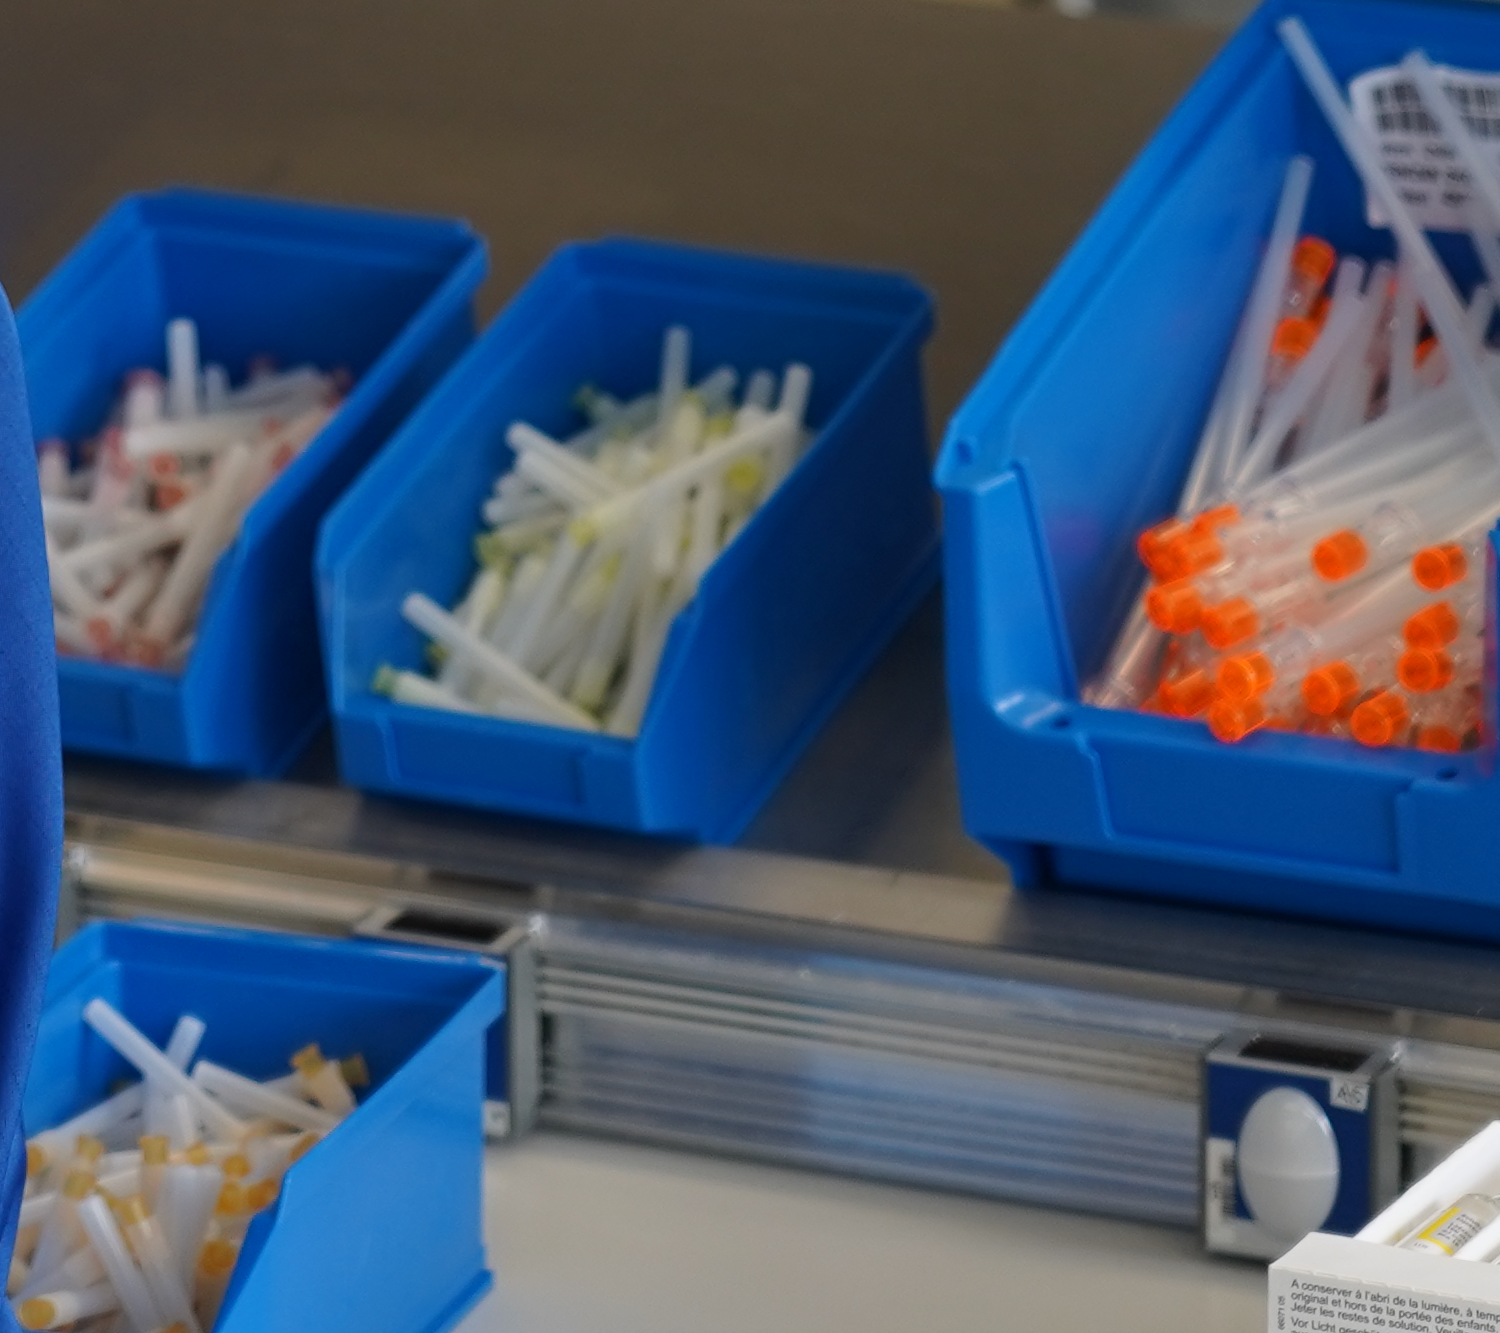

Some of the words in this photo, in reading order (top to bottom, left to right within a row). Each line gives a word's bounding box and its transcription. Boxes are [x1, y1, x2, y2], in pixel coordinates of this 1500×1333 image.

[1291, 1279, 1300, 1289] A
[1301, 1283, 1353, 1298] conserver
[1355, 1288, 1362, 1299] à
[1365, 1291, 1390, 1304] l'abri
[1393, 1295, 1406, 1307] de
[1409, 1297, 1418, 1309] la
[1421, 1299, 1463, 1318] lumière,
[1467, 1307, 1474, 1318] à
[1291, 1291, 1329, 1308] original
[1331, 1298, 1341, 1308] et
[1344, 1299, 1367, 1313] hors
[1370, 1303, 1383, 1315] de
[1386, 1305, 1396, 1317] la
[1399, 1307, 1431, 1324] portée
[1434, 1313, 1453, 1327] des
[1457, 1315, 1498, 1333] enfants.
[1290, 1303, 1317, 1316] Jeter
[1319, 1307, 1335, 1318] les
[1337, 1310, 1369, 1325] restes
[1372, 1314, 1385, 1326] de
[1389, 1317, 1432, 1333] solution.
[1290, 1316, 1309, 1329] Vor
[1311, 1319, 1336, 1333] Licht
